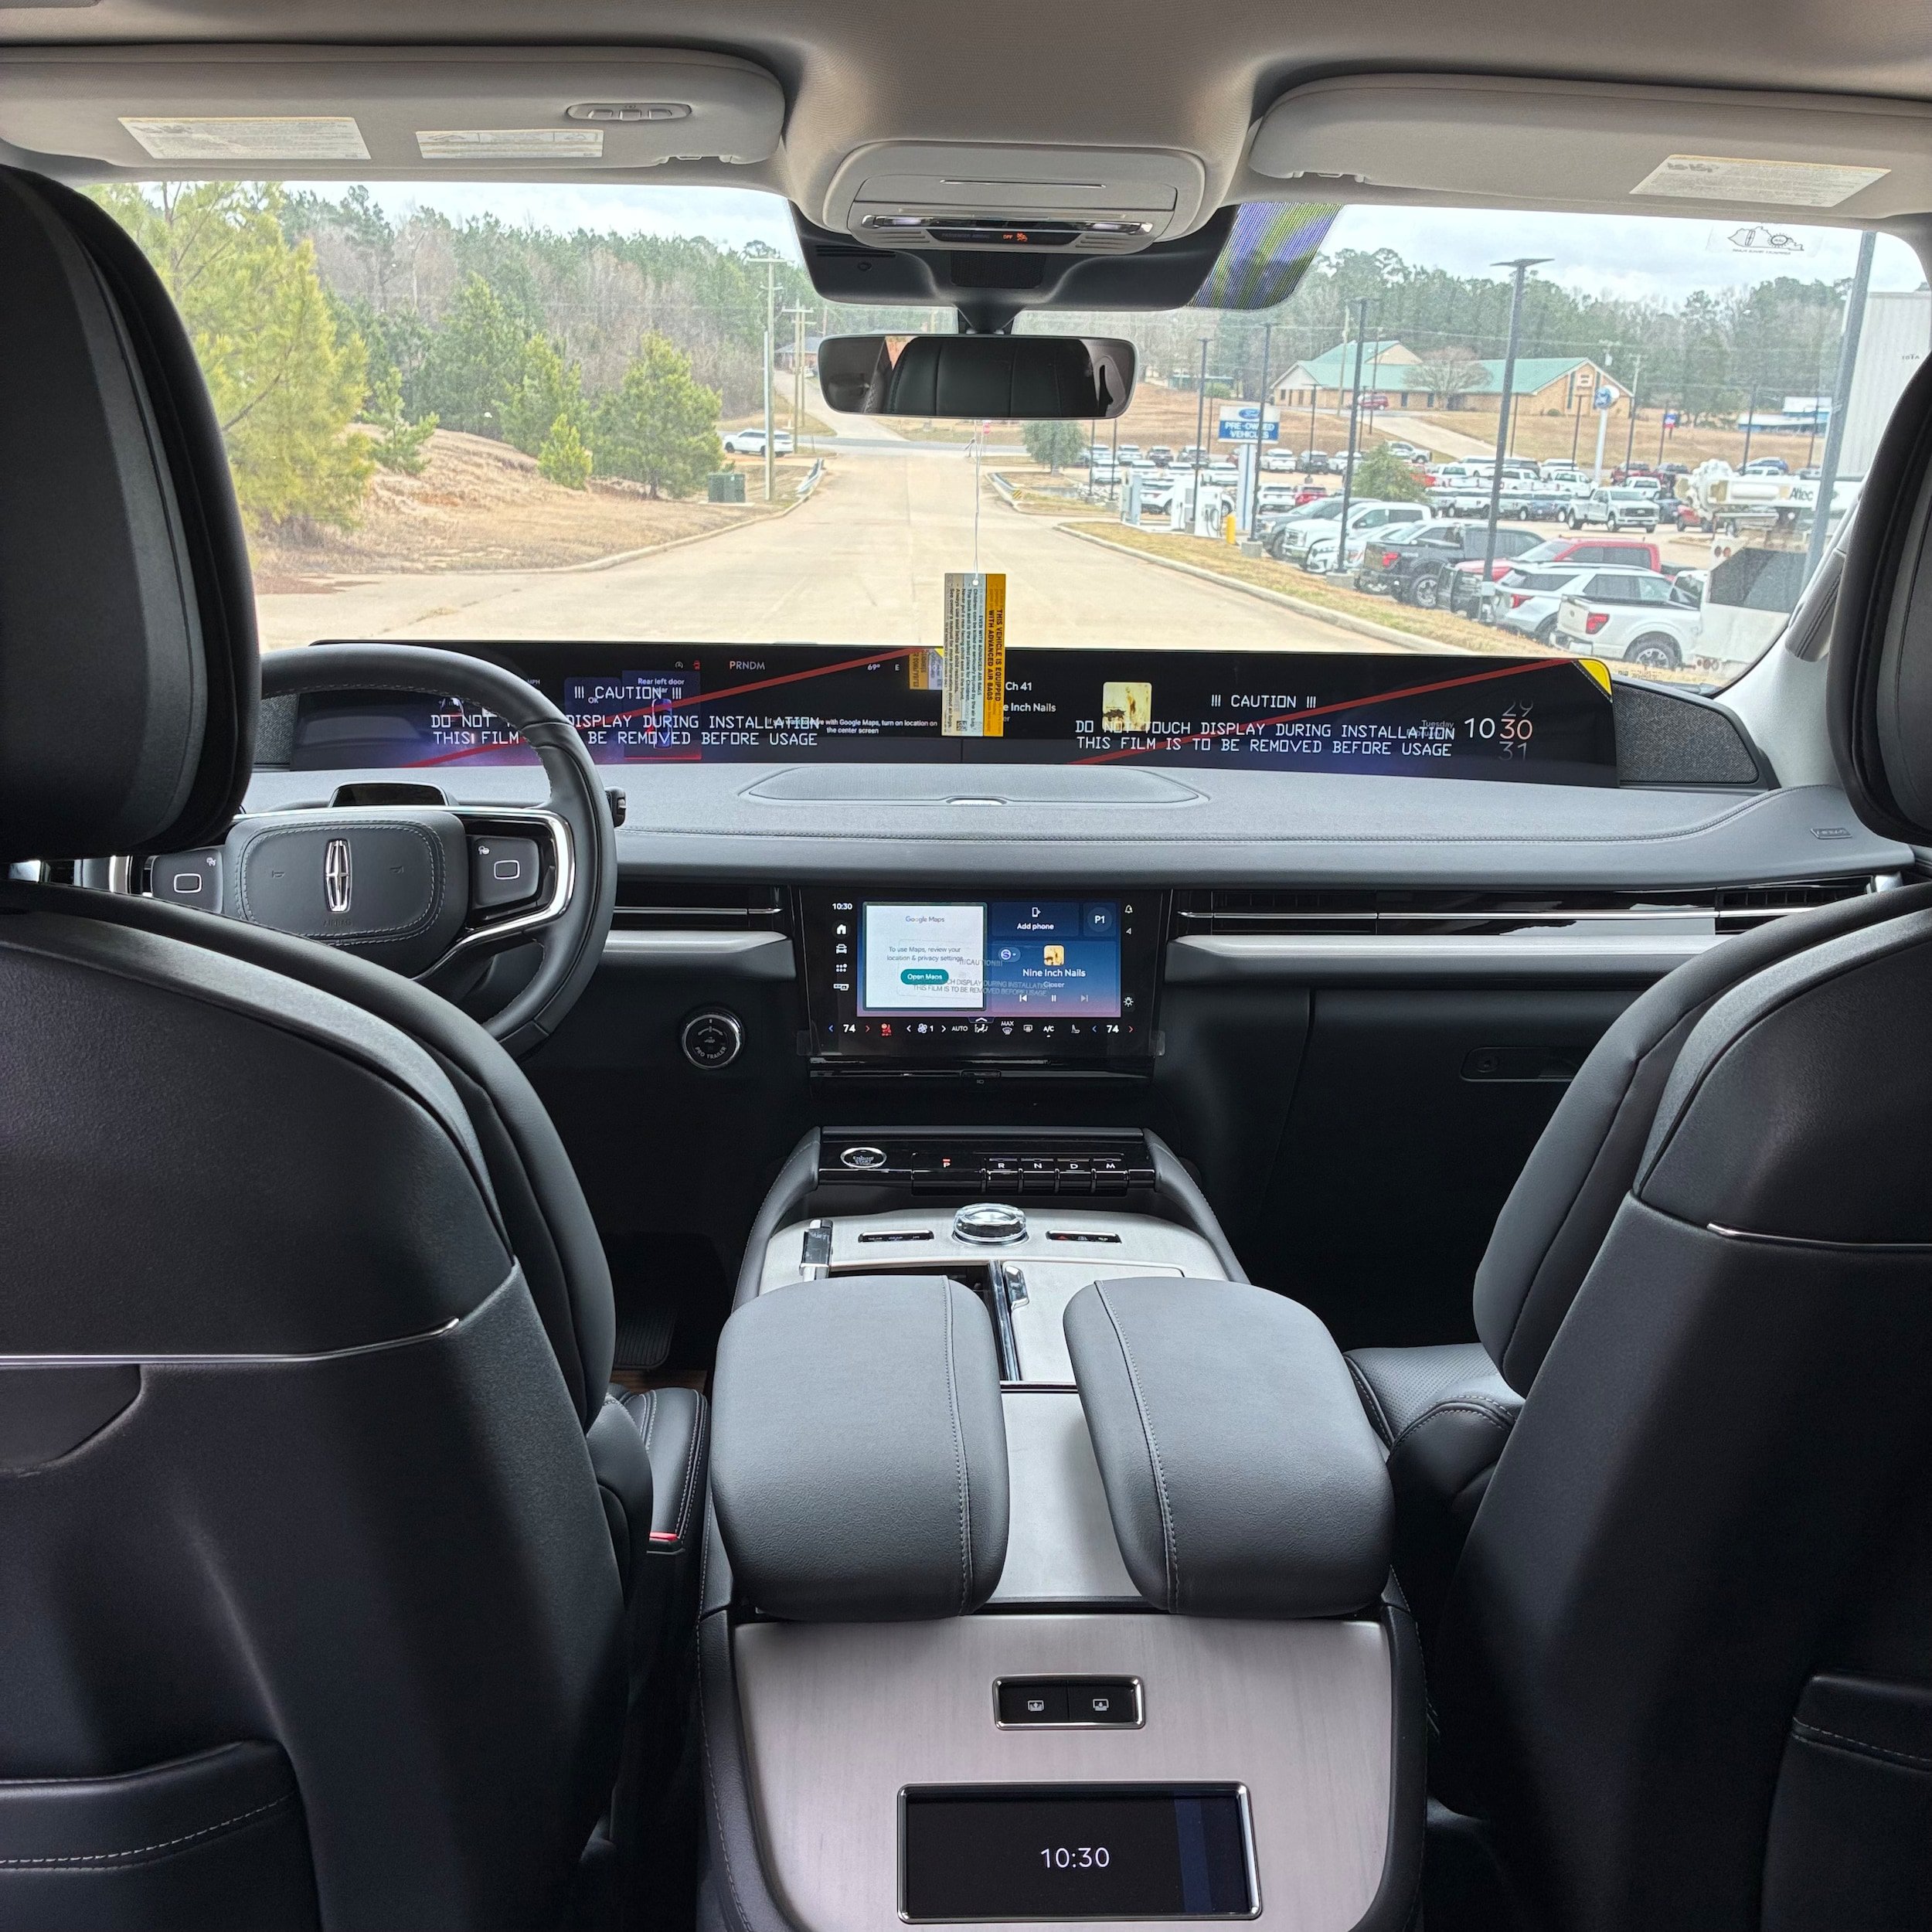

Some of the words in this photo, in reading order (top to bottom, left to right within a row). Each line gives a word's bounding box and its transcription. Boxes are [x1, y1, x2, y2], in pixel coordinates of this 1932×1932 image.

[1225, 422, 1275, 431] PRE-OWED
[1789, 487, 1814, 501] Altec
[594, 686, 662, 699] CAUTION
[1005, 682, 1019, 691] Ch
[1020, 682, 1032, 691] 41
[1011, 702, 1031, 712] Inch
[1033, 703, 1056, 712] Nails
[1231, 695, 1297, 708] CAUTION
[431, 714, 451, 728] DO
[462, 714, 492, 728] NOT
[643, 715, 699, 729] DURING
[709, 716, 819, 730] INSTALLATION
[839, 719, 862, 727] Google
[862, 719, 881, 727] Maps,
[1421, 719, 1454, 729] Tuesday
[1464, 717, 1496, 740] 10
[1499, 718, 1533, 740] 30
[1075, 720, 1094, 733] DO
[1104, 721, 1131, 733] NOT
[1145, 721, 1191, 734] TOUCH
[1201, 722, 1265, 736] DISPLAY
[1276, 723, 1331, 737] DURING
[1342, 724, 1455, 740] INSTALLATION
[481, 731, 519, 744] FILM
[588, 731, 607, 744] BE
[618, 731, 691, 745] REMOVED
[702, 732, 759, 745] BEFORE
[770, 733, 818, 746] USAGE
[1077, 736, 1111, 750] THIS
[1121, 736, 1156, 750] FILM
[1166, 737, 1182, 750] IS
[1192, 738, 1211, 750] TO
[1221, 739, 1240, 751] BE
[1250, 739, 1322, 753] REMOVED
[1332, 740, 1392, 755] BEFORE
[1402, 743, 1452, 757] USAGE
[1498, 741, 1528, 761] 31
[1094, 915, 1105, 924] P1
[1065, 969, 1087, 978] Nails
[843, 1024, 856, 1033] 74
[1106, 1025, 1119, 1033] 74
[695, 1046, 705, 1057] PRO
[707, 1046, 727, 1060] TRAILER
[1040, 1846, 1111, 1869] 10:30
